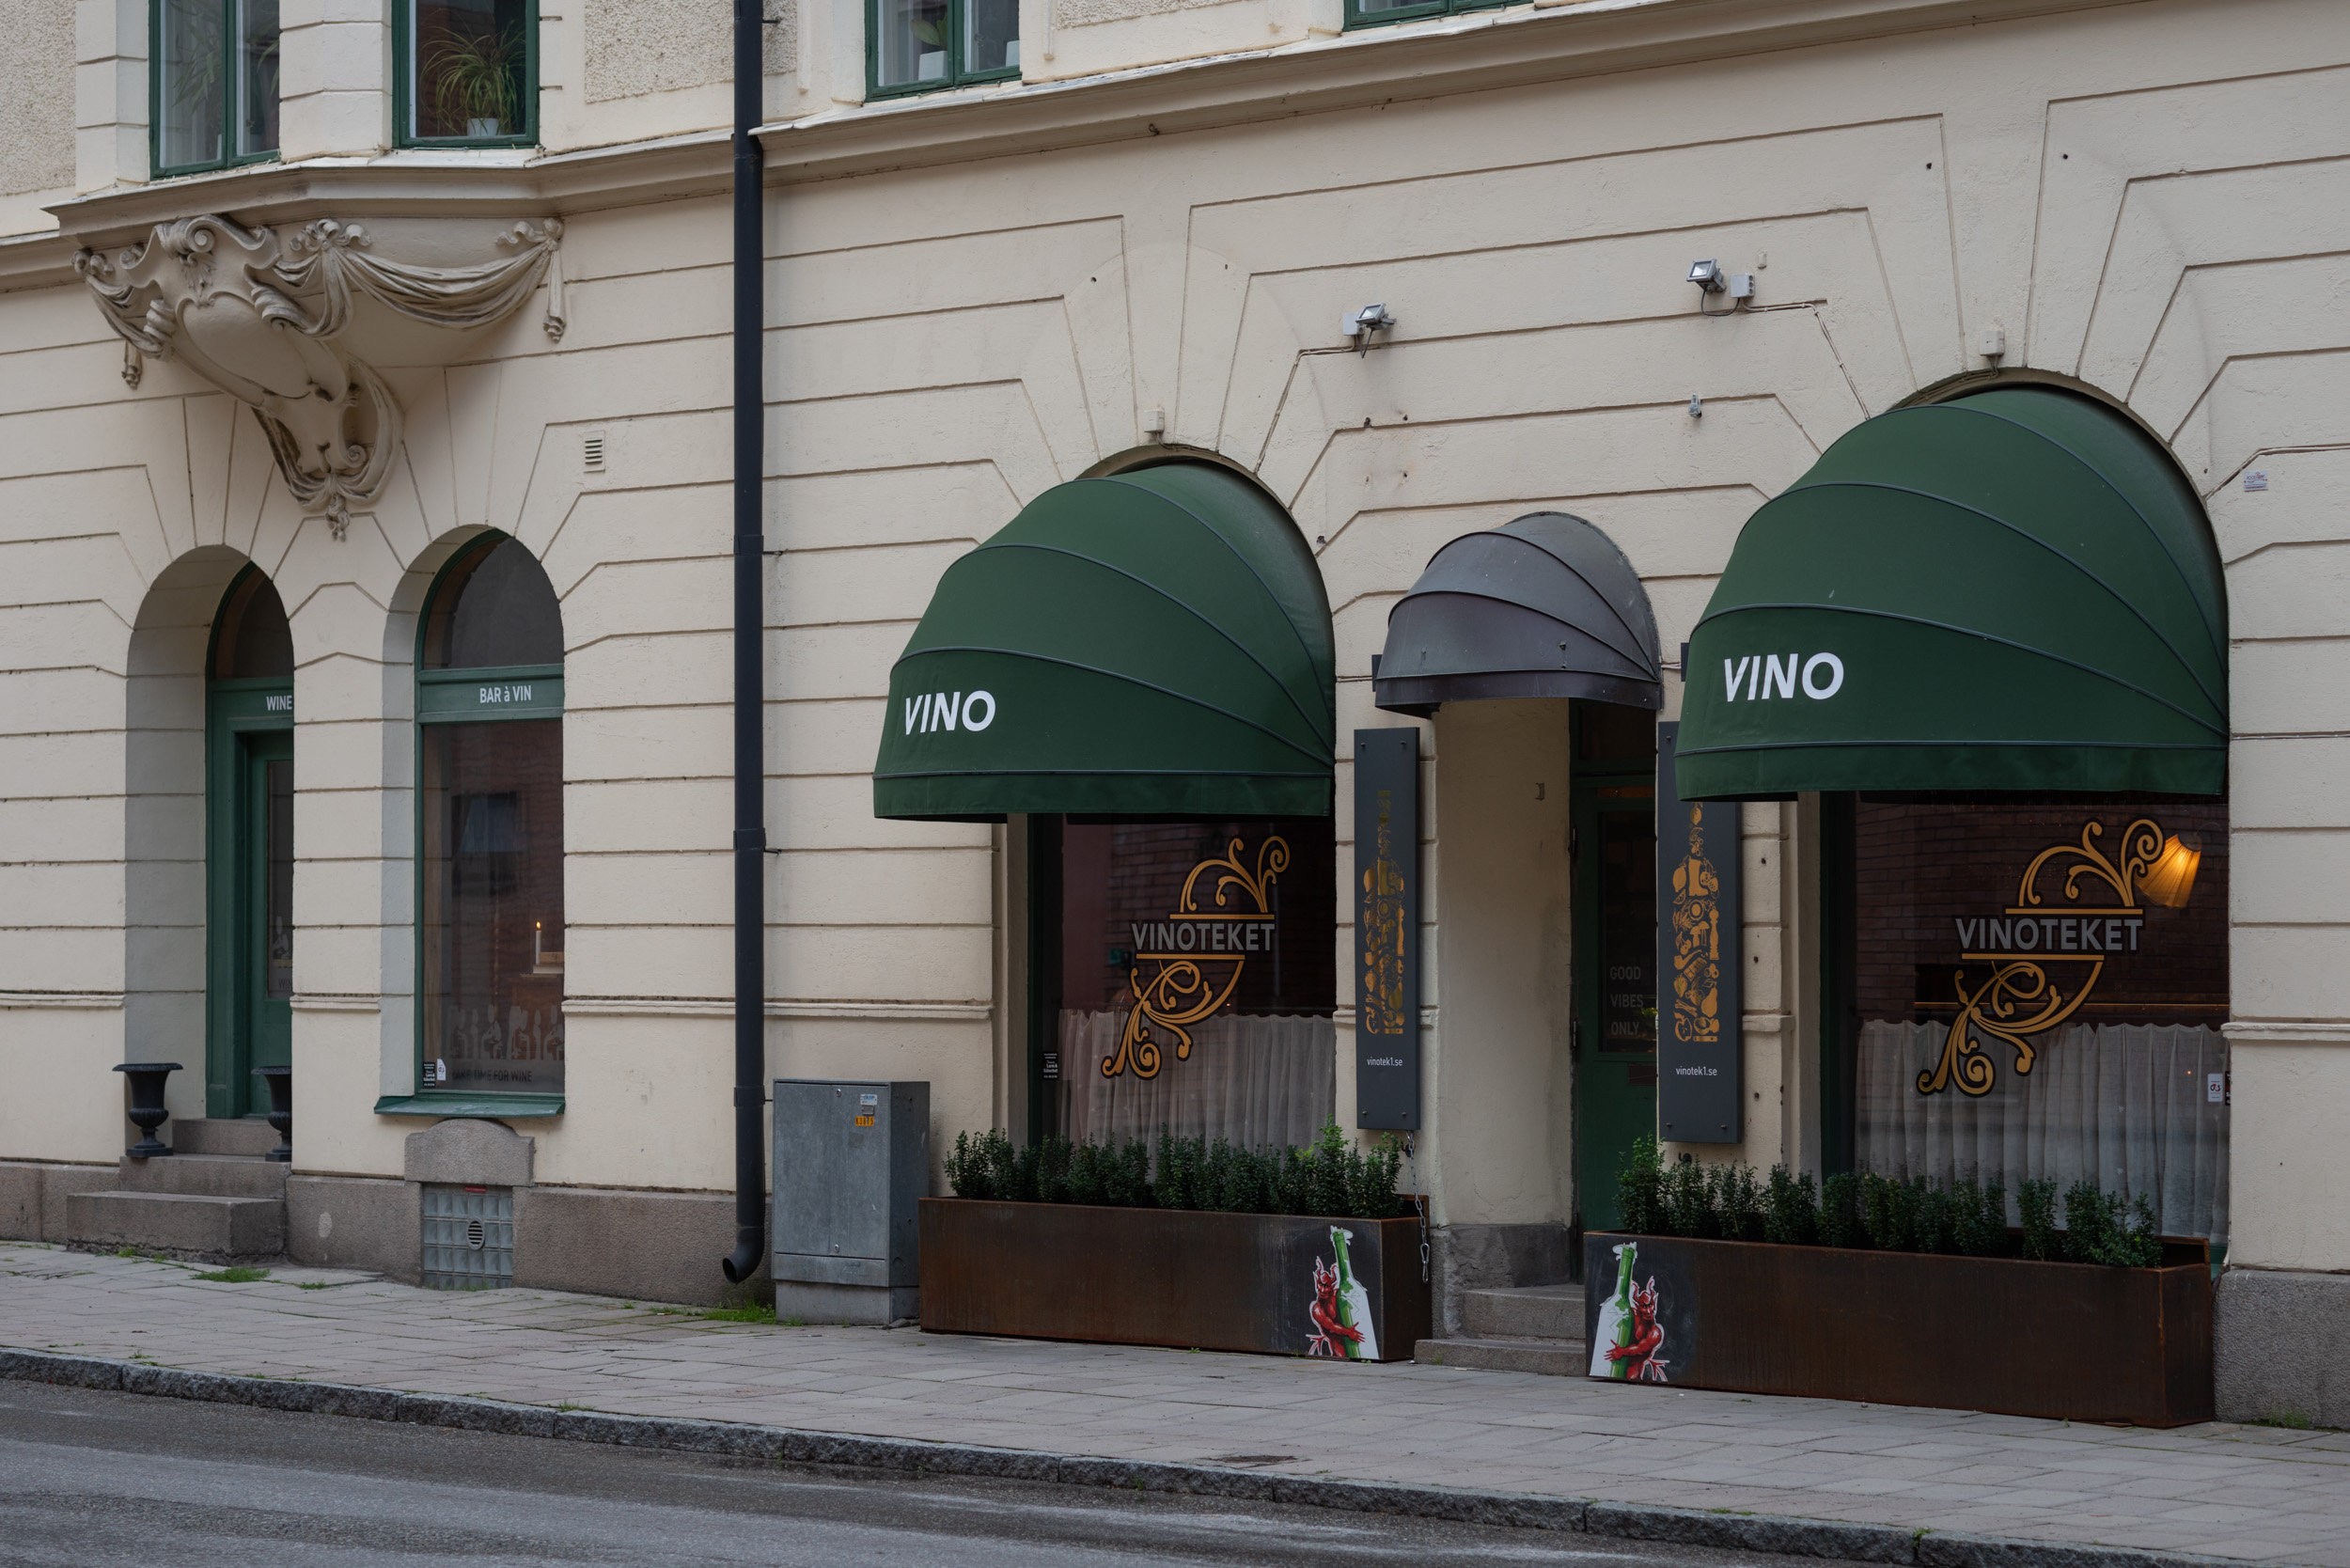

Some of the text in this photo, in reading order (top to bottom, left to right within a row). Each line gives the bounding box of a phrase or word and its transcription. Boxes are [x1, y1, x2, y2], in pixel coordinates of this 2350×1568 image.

[1724, 651, 1844, 702] VINO
[479, 684, 532, 703] BAR à VIN
[266, 695, 292, 711] WINE
[905, 690, 996, 735] VINO
[1131, 922, 1276, 951] VINOTEKET
[1955, 917, 2143, 950] VINOTEKET
[1609, 966, 1641, 980] GOOD
[1610, 994, 1644, 1008] VIBES
[1610, 1021, 1640, 1036] ONLY
[1366, 1056, 1403, 1067] vinotek1.se
[474, 1069, 492, 1082] TIME
[494, 1070, 509, 1082] FOR
[510, 1070, 533, 1083] WINE
[1675, 1065, 1718, 1076] vinotek1.se
